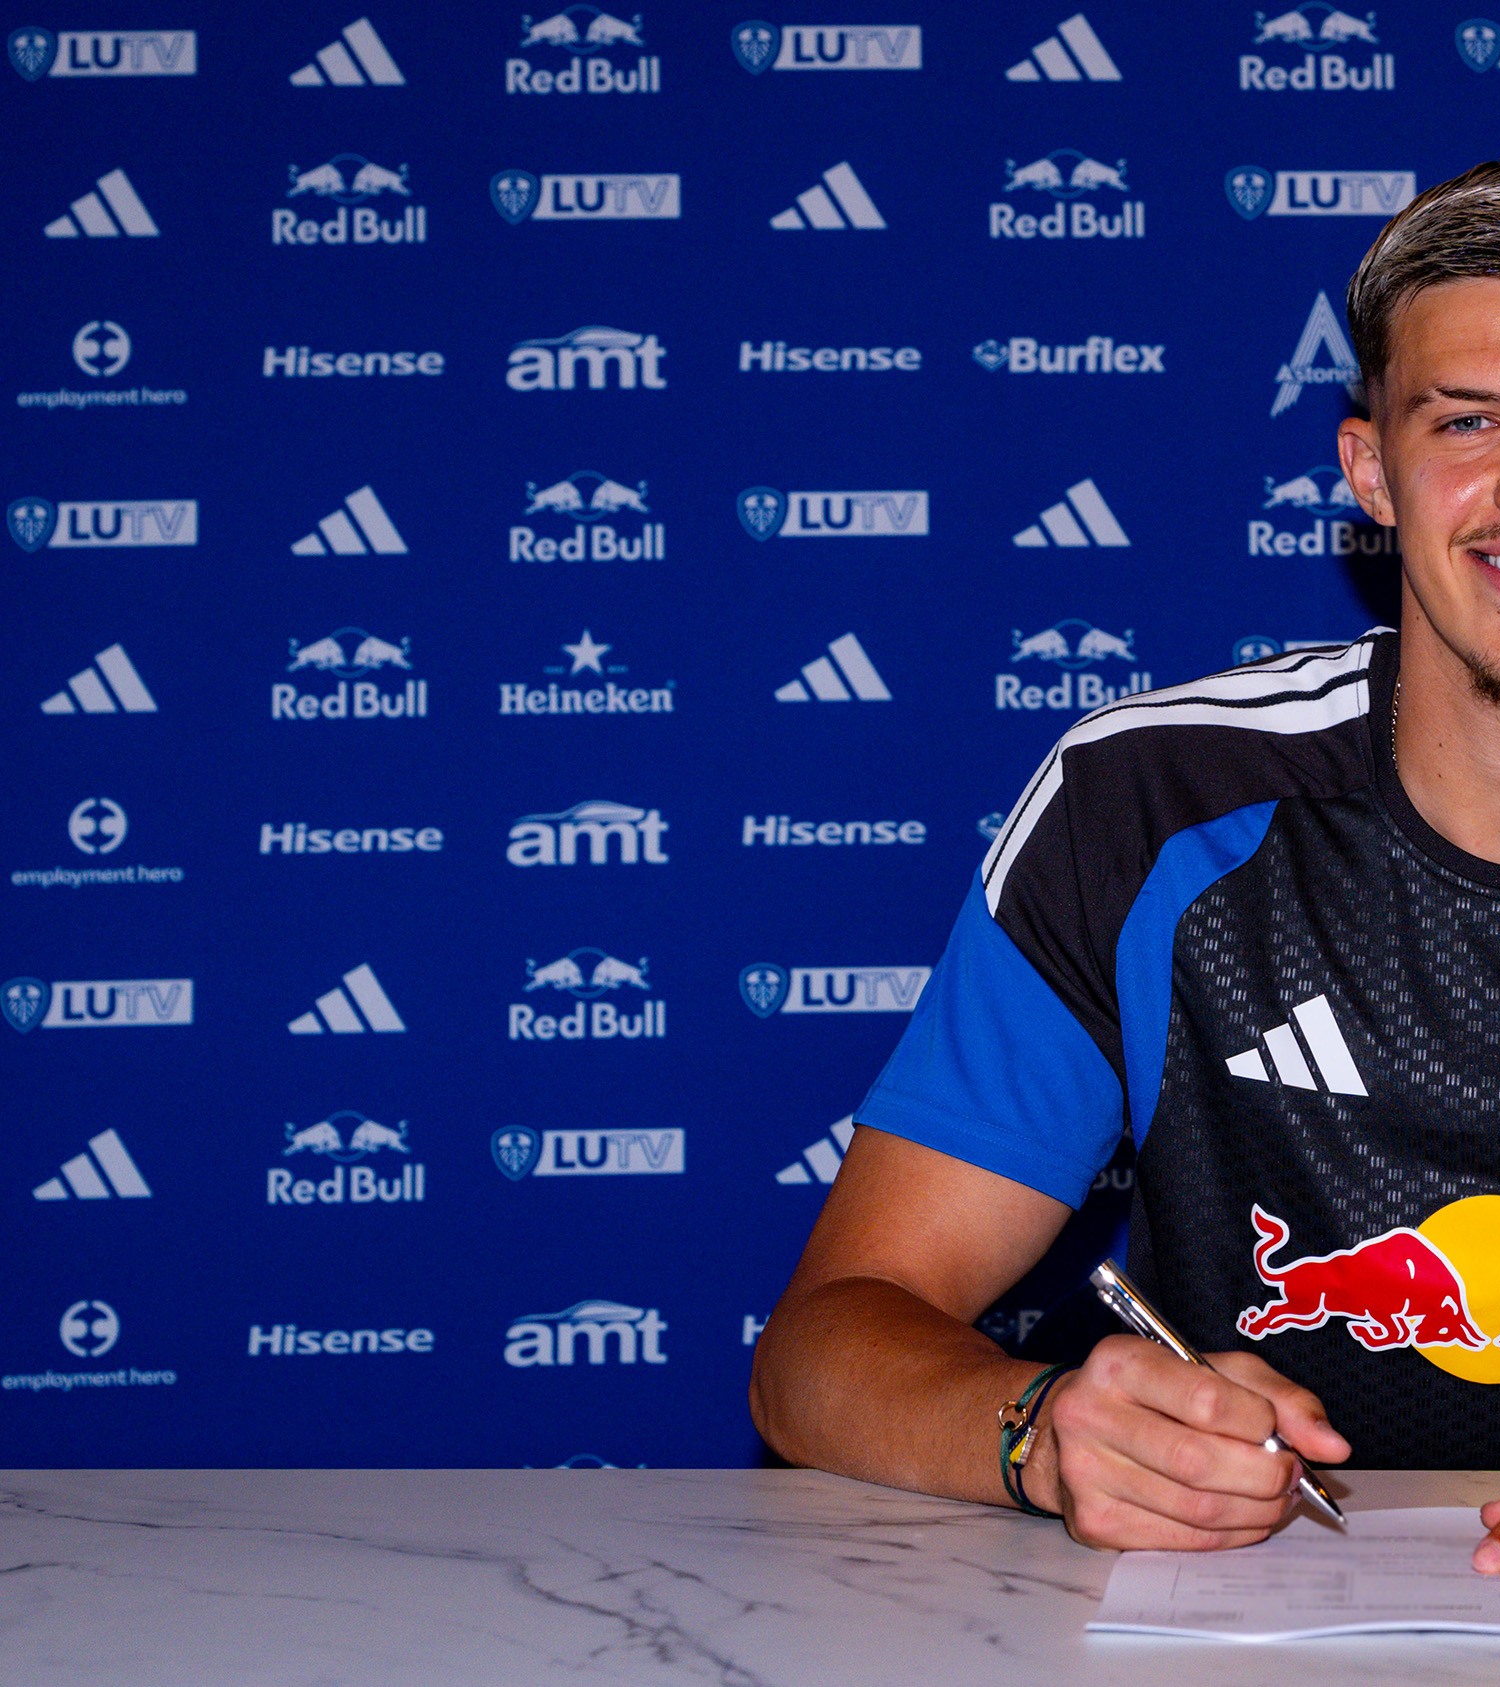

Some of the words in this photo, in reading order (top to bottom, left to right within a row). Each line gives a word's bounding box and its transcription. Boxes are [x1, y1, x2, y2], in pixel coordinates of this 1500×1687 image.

[506, 57, 581, 94] Red
[587, 56, 660, 93] Bull
[1239, 54, 1316, 91] Red
[1321, 54, 1395, 91] Bull
[272, 207, 347, 244] Red
[353, 206, 426, 243] Bull
[989, 202, 1066, 238] Red
[1071, 201, 1145, 238] Bull
[263, 346, 444, 377] Hisense
[506, 334, 666, 391] amt
[739, 341, 921, 371] Hisense
[1007, 336, 1164, 373] Burflex
[141, 385, 186, 404] hero
[509, 524, 585, 562] Red
[591, 523, 664, 561] Bull
[1249, 519, 1325, 557] Red
[1330, 519, 1401, 556] Bul
[272, 681, 347, 719] Red
[353, 680, 427, 718] Bull
[500, 683, 673, 714] Heineken
[995, 672, 1072, 710] Red
[259, 823, 443, 854] Hisense
[506, 808, 668, 867] amt
[742, 815, 926, 846] Hisense
[137, 864, 182, 882] hero
[509, 1001, 585, 1040] Red
[591, 1000, 665, 1038] Bull
[267, 1166, 344, 1204] Red
[350, 1164, 424, 1202] Bull
[248, 1325, 434, 1355] Hisense
[504, 1308, 667, 1367] amt
[129, 1367, 176, 1386] hero
